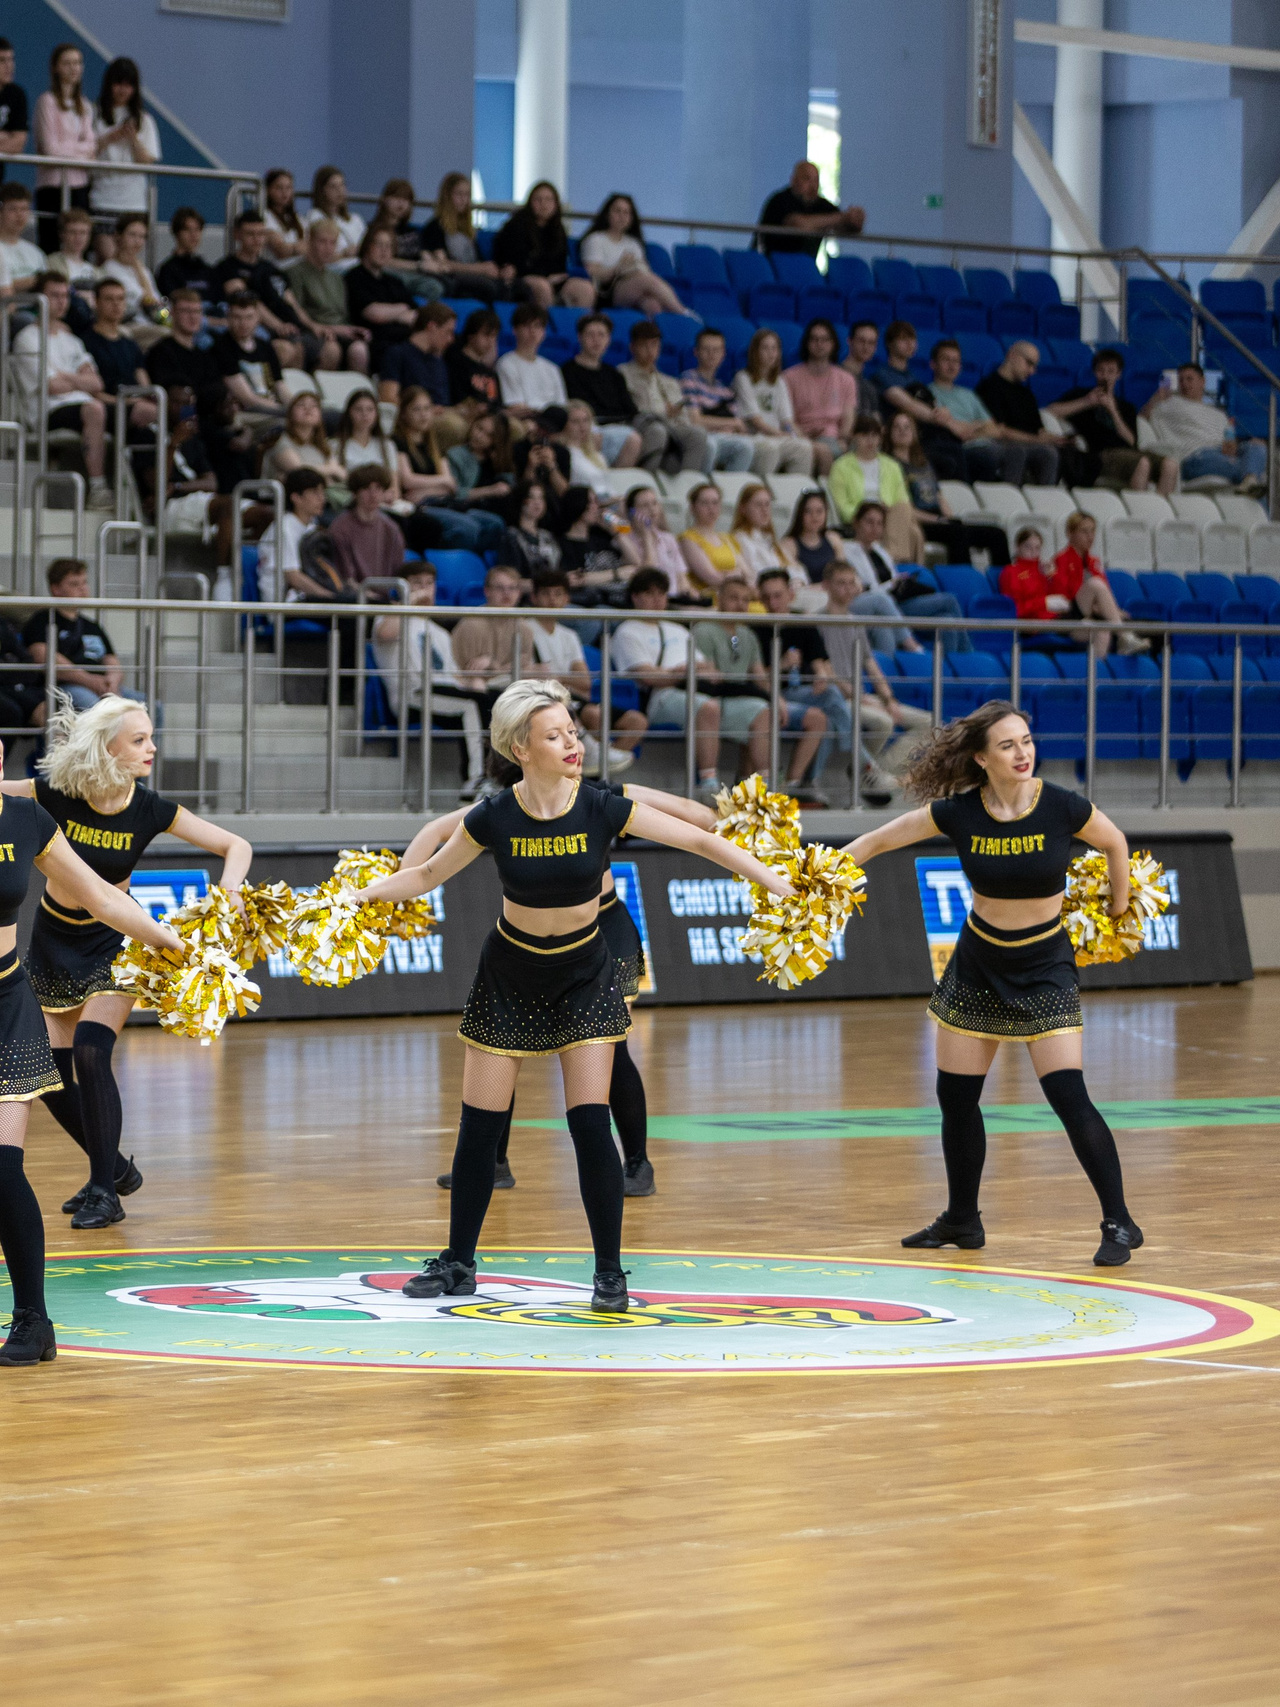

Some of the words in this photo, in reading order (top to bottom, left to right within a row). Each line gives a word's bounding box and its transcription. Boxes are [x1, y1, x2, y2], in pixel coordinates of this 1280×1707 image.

[65, 819, 134, 851] TIMEOUT
[510, 833, 588, 857] TIMEOUT
[970, 834, 1045, 856] TIMEOUT
